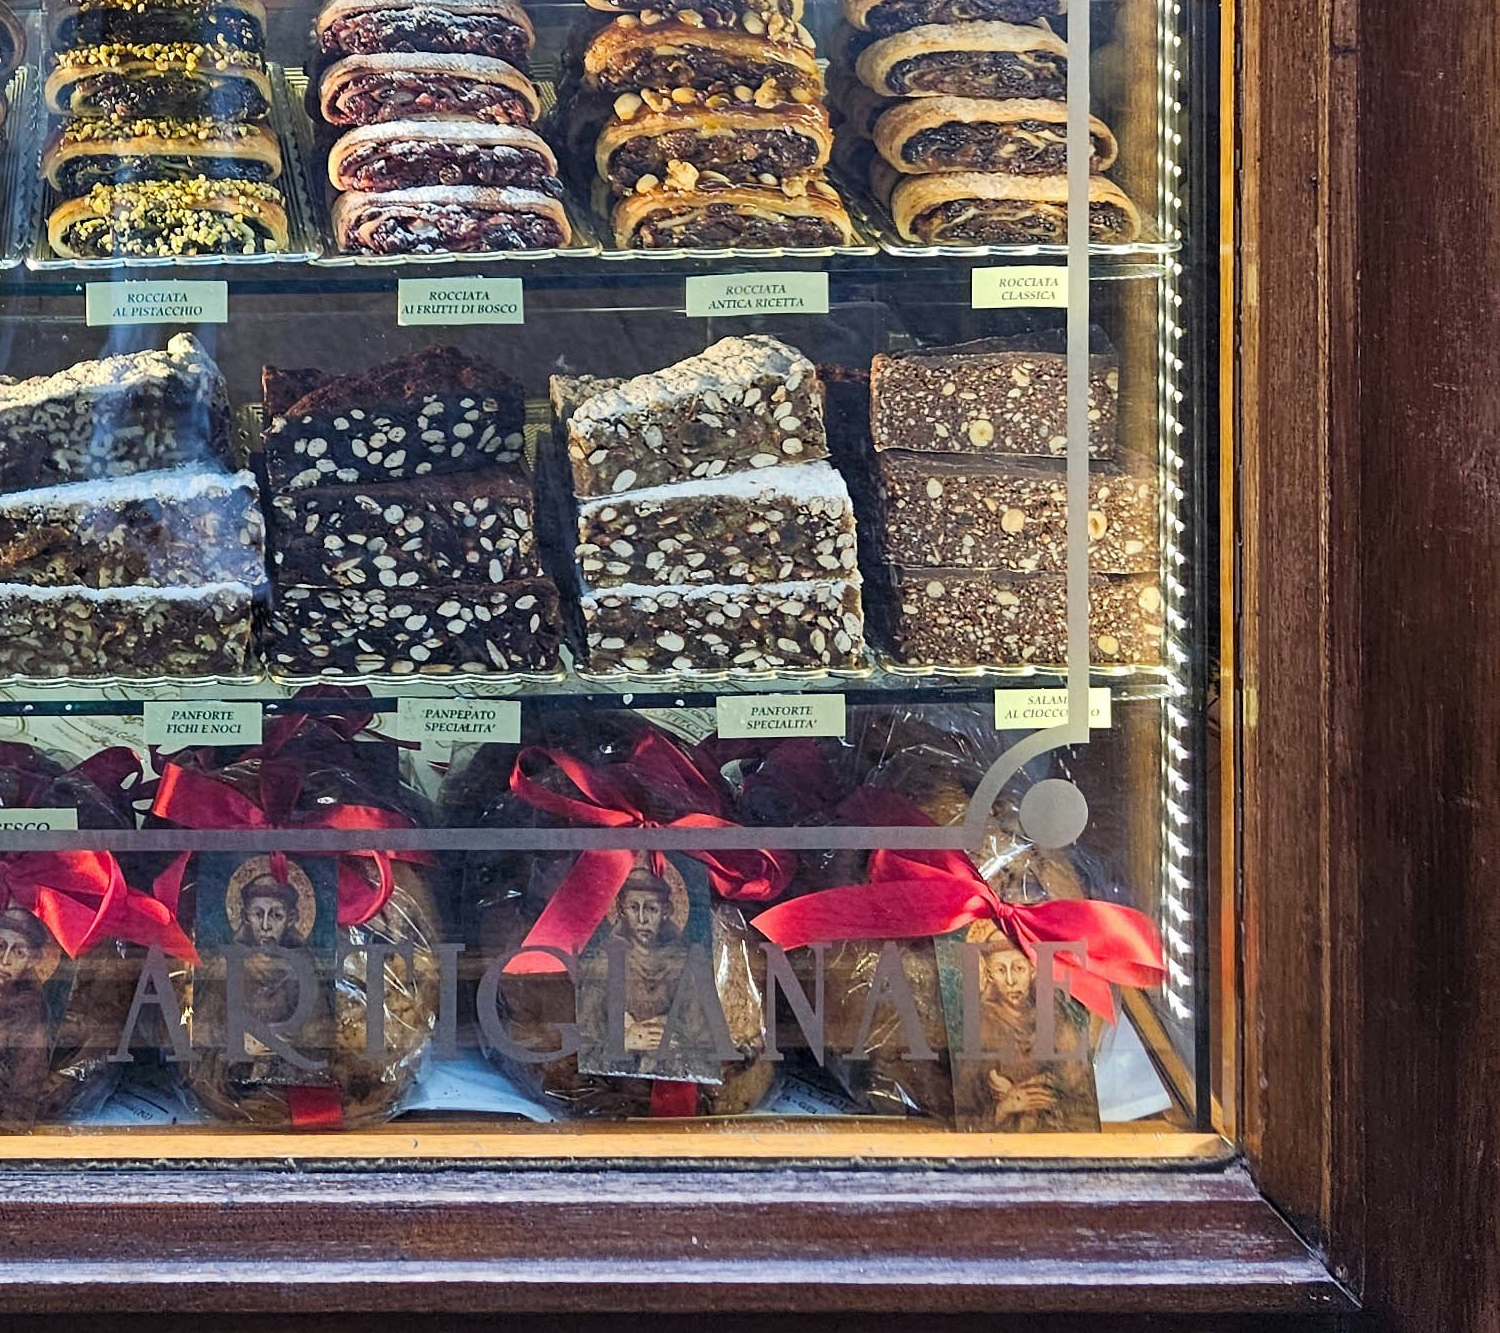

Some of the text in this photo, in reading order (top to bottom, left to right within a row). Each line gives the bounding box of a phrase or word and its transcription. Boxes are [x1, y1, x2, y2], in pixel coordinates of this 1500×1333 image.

[999, 277, 1059, 288] ROCCIATA
[429, 290, 490, 301] ROCCIATA
[726, 284, 787, 296] ROCCIATA
[1000, 290, 1057, 301] CLASSICA
[127, 292, 189, 304] ROCCIATA
[707, 297, 805, 310] ANTICA RICETTA
[112, 306, 204, 318] AL PISTACCHIO
[401, 303, 518, 315] AI FRUTTI DI BOSCO
[1027, 696, 1069, 707] SALAM
[171, 710, 235, 721] PANFORTE
[425, 709, 497, 721] PANPEPATO
[750, 706, 814, 717] PANFORTE
[1004, 710, 1021, 720] AL
[166, 723, 242, 734] FICHI E NOCI
[424, 723, 497, 734] SPECIALITA'
[746, 719, 818, 730] SPECIALITA'
[116, 941, 1094, 1069] ARTIGIANALE
